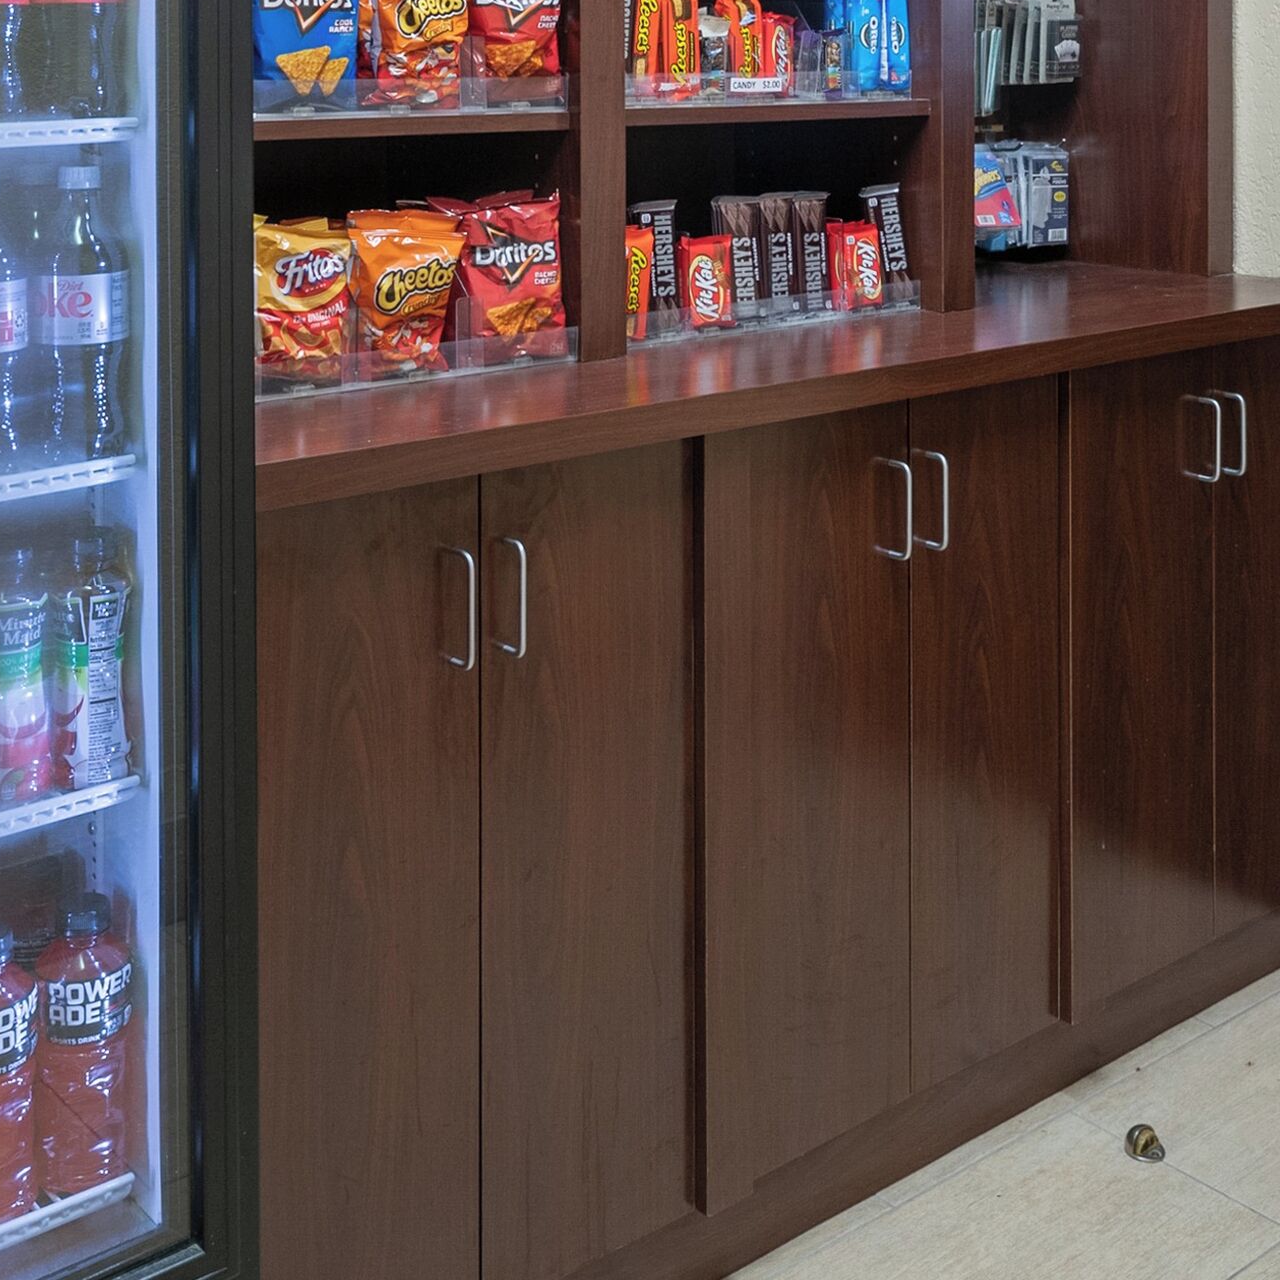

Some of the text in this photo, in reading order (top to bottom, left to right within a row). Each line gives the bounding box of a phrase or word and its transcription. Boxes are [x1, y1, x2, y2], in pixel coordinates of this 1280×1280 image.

[671, 21, 687, 85] Reese's
[870, 16, 878, 54] OREO
[891, 16, 899, 54] OREO
[733, 81, 756, 90] CANDY
[881, 197, 907, 271] HERSHEY'S
[476, 241, 556, 266] Doritos
[654, 215, 676, 297] HERSHEY'S
[804, 232, 823, 309] HERSHEY'S
[57, 280, 84, 292] Diet
[275, 251, 345, 295] Fritos
[378, 261, 455, 309] Cheetos
[627, 247, 647, 312] Reese's
[307, 300, 346, 323] ORIGINAL
[4, 626, 41, 646] Maid
[48, 963, 131, 1004] POWER
[49, 1001, 101, 1026] ADE
[77, 1034, 101, 1044] DRINK
